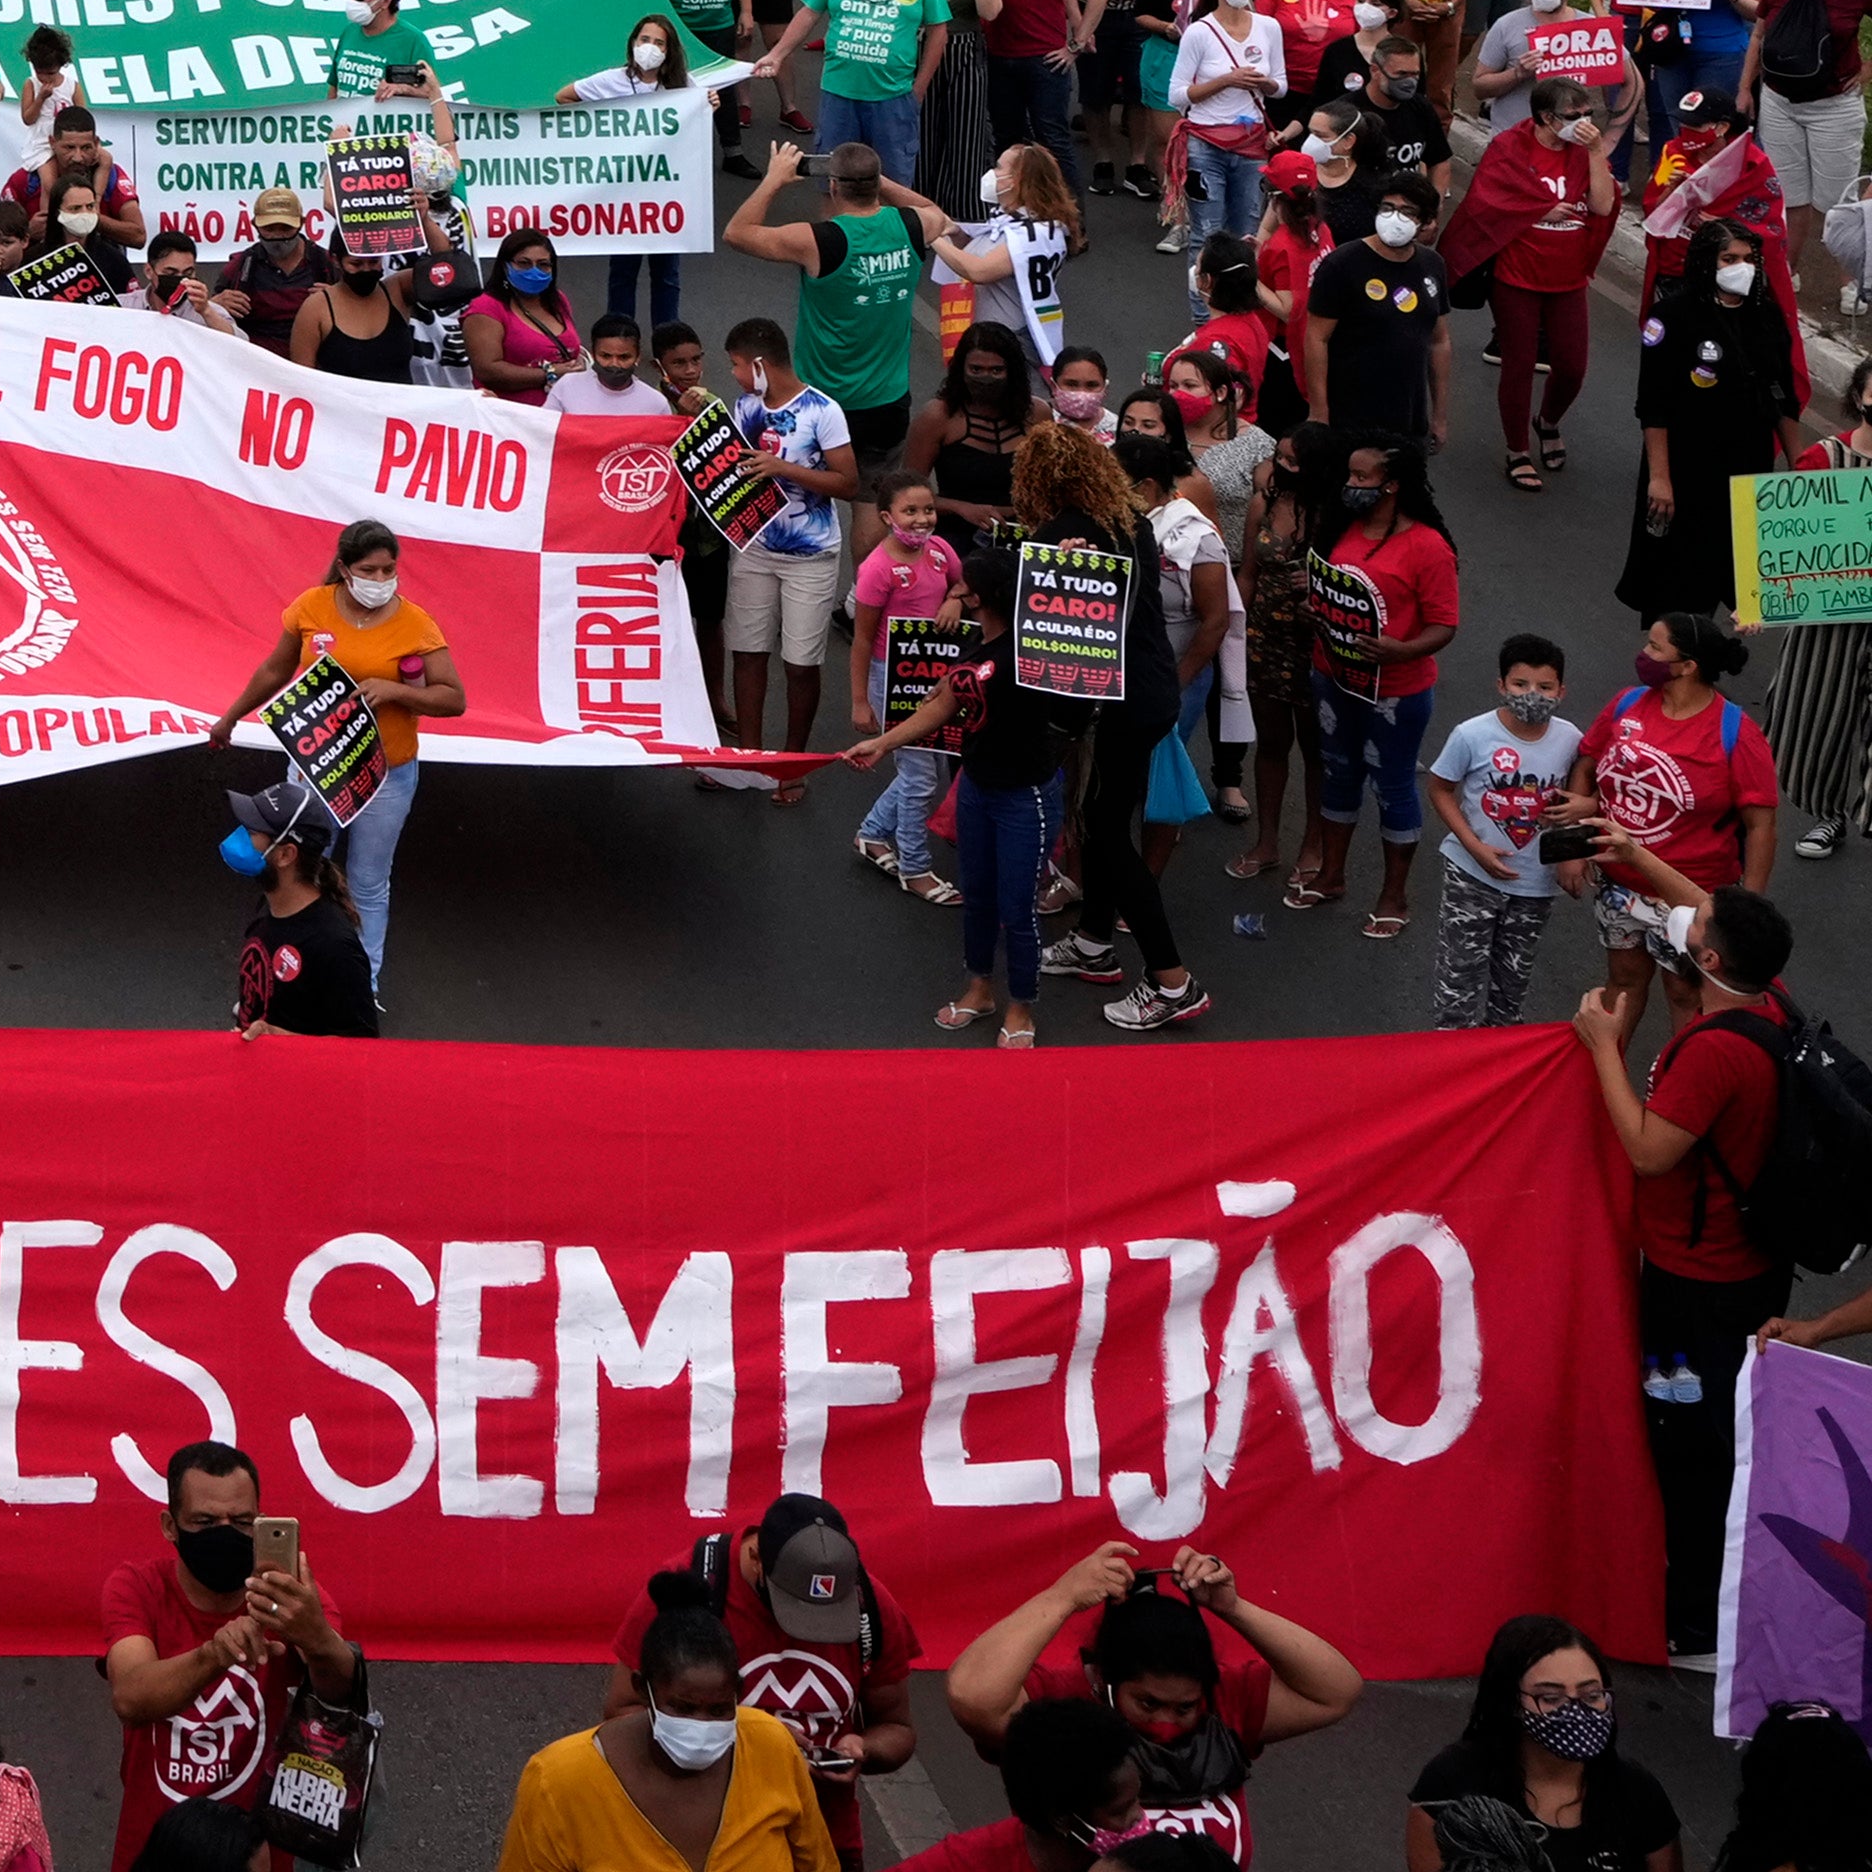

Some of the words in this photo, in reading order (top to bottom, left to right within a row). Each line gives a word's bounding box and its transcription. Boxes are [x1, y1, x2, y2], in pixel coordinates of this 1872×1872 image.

[1535, 30, 1615, 55] FORA
[155, 114, 334, 147] SERVIDORES
[539, 105, 681, 140] FEDERAIS
[157, 158, 266, 192] CONTRA
[336, 154, 360, 173] TÁ
[362, 153, 405, 171] TUDO
[339, 171, 409, 194] CARO!
[158, 198, 231, 245] NÃO
[486, 201, 685, 240] BOLSONARO
[868, 246, 912, 276] MARÉ
[34, 338, 184, 434] FOGO
[239, 387, 315, 471] NO
[374, 417, 528, 514] PAVIO
[702, 424, 732, 457] TUDO
[1756, 475, 1850, 512] 600MIL
[1759, 517, 1838, 541] PORQUE
[1029, 570, 1056, 590] TÁ
[1058, 577, 1118, 597] TUDO
[1026, 593, 1116, 622] CARO!
[1035, 621, 1081, 636] CULPA
[1096, 628, 1118, 642] DO
[280, 705, 312, 737] TÁ
[305, 676, 349, 717] TUDO
[295, 694, 358, 756] CARO!
[316, 733, 352, 770] CULPA
[284, 1226, 737, 1522] SEM
[779, 1178, 1483, 1542] FEIJÃO
[167, 1761, 233, 1785] BRASIL
[275, 1763, 348, 1804] RUBRO
[268, 1789, 340, 1830] NEGRA
